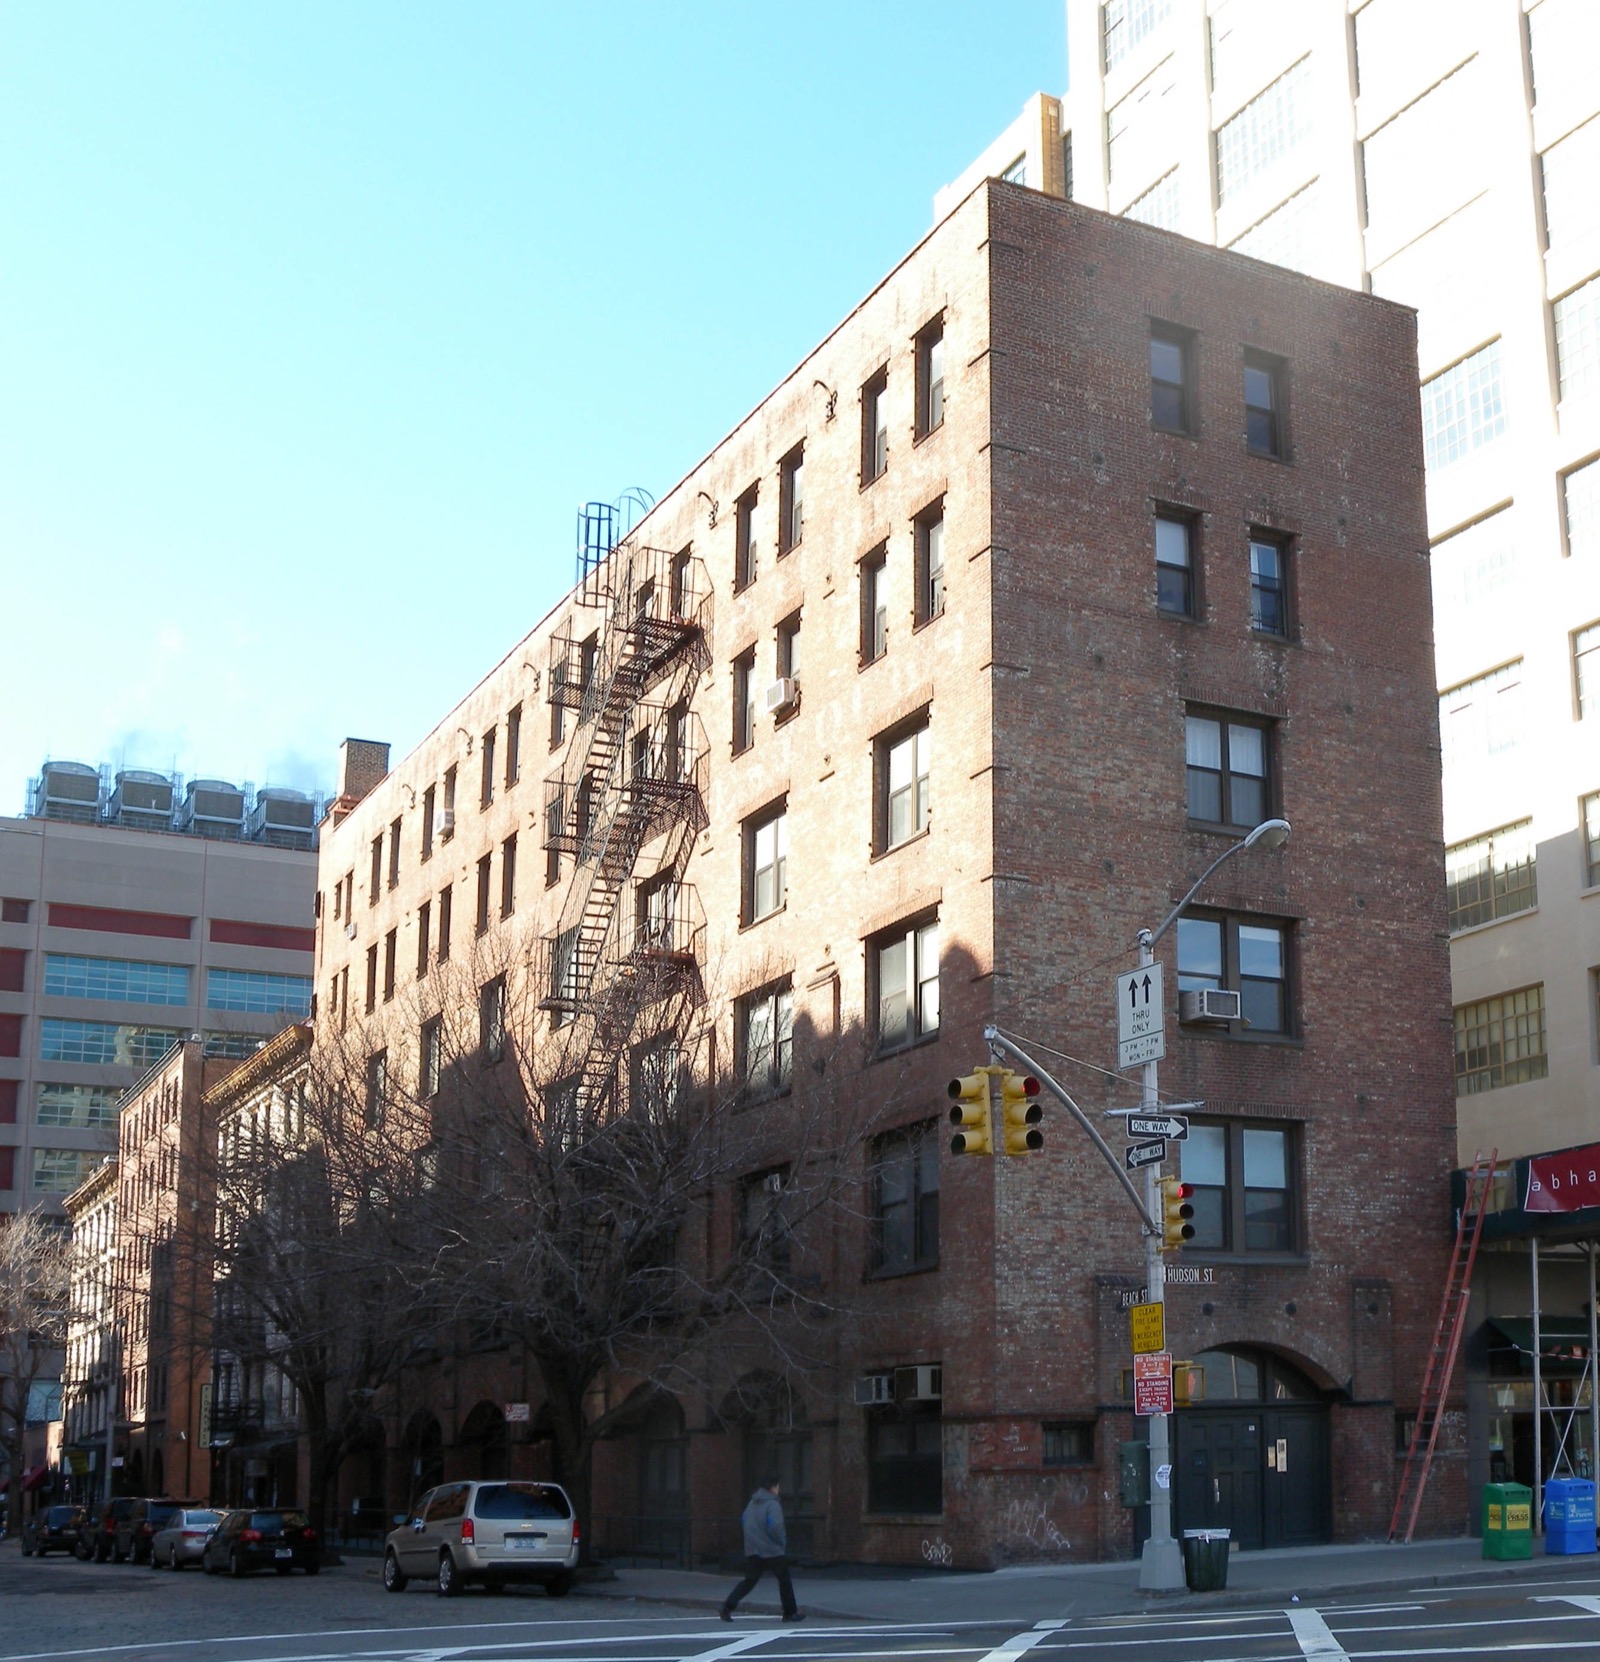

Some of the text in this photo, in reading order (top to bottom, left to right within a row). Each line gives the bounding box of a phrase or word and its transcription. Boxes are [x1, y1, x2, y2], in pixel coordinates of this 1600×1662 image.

[1132, 1009, 1150, 1022] THRU
[1132, 1021, 1150, 1034] ONLY
[1133, 1121, 1169, 1132] ONE WAY
[1131, 1145, 1162, 1162] ONE WAY
[1167, 1268, 1214, 1282] HUDSON ST
[1122, 1288, 1148, 1306] BEACH ST
[1138, 1306, 1156, 1316] CLEAR
[1135, 1315, 1160, 1325] FIRE LANE
[1134, 1330, 1161, 1340] EMERGENCY
